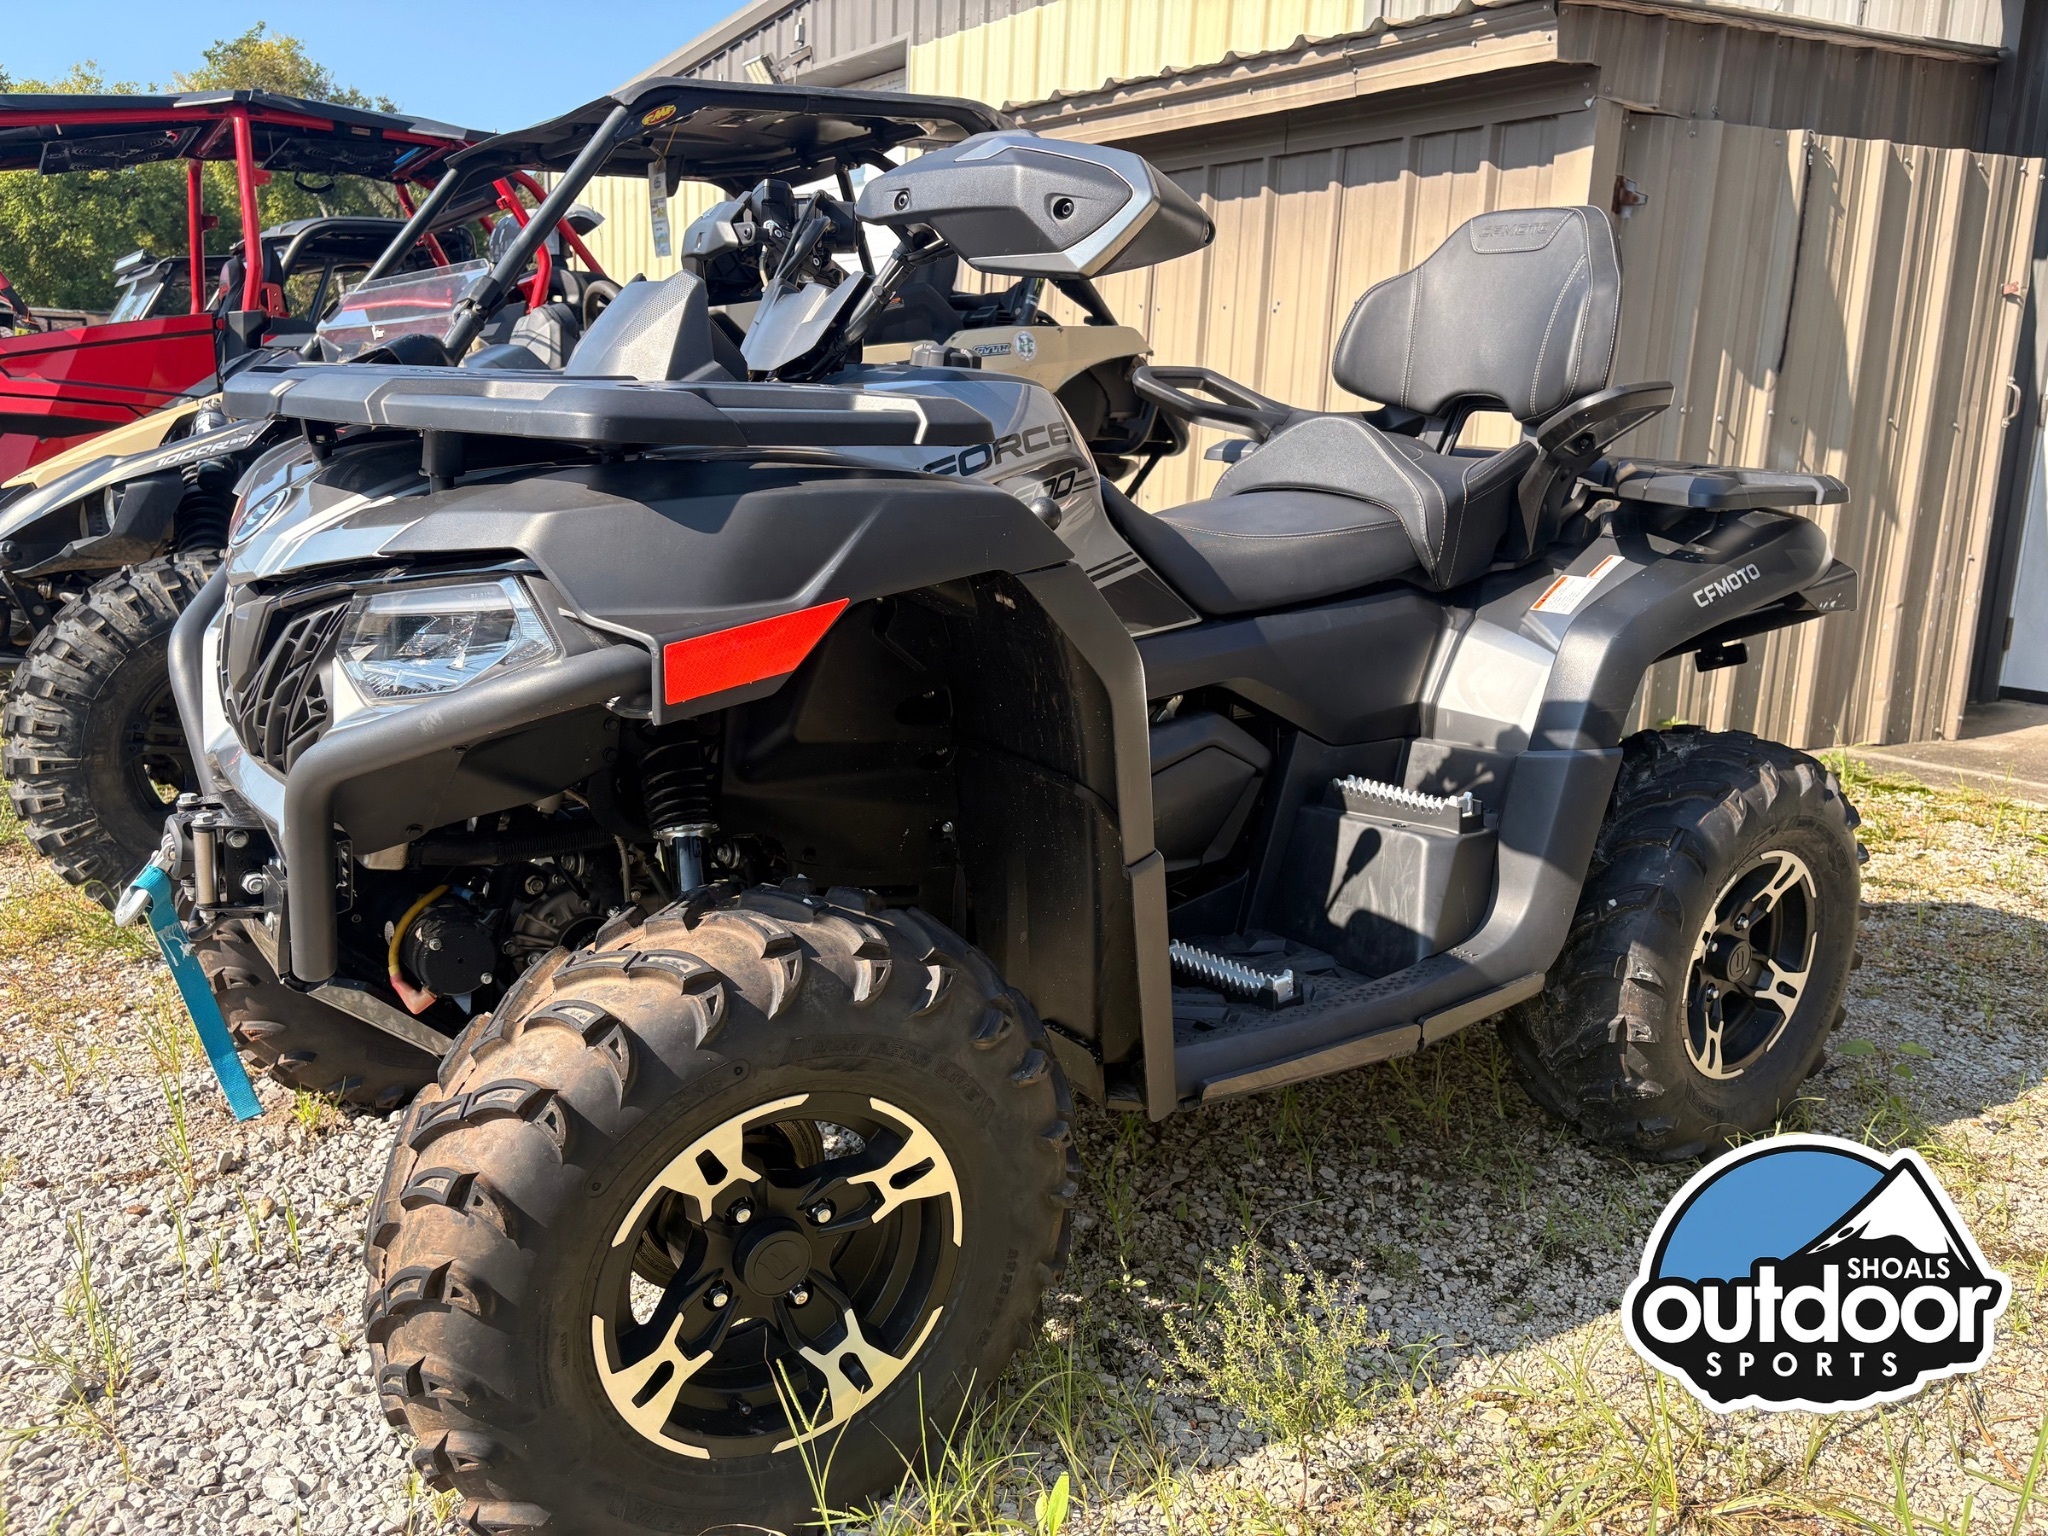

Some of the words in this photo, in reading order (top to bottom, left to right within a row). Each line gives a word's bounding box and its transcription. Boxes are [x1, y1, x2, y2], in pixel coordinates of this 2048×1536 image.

[1478, 221, 1550, 238] CFMOTO
[916, 421, 1071, 476] FORCE
[1692, 563, 1761, 608] CFMOTO
